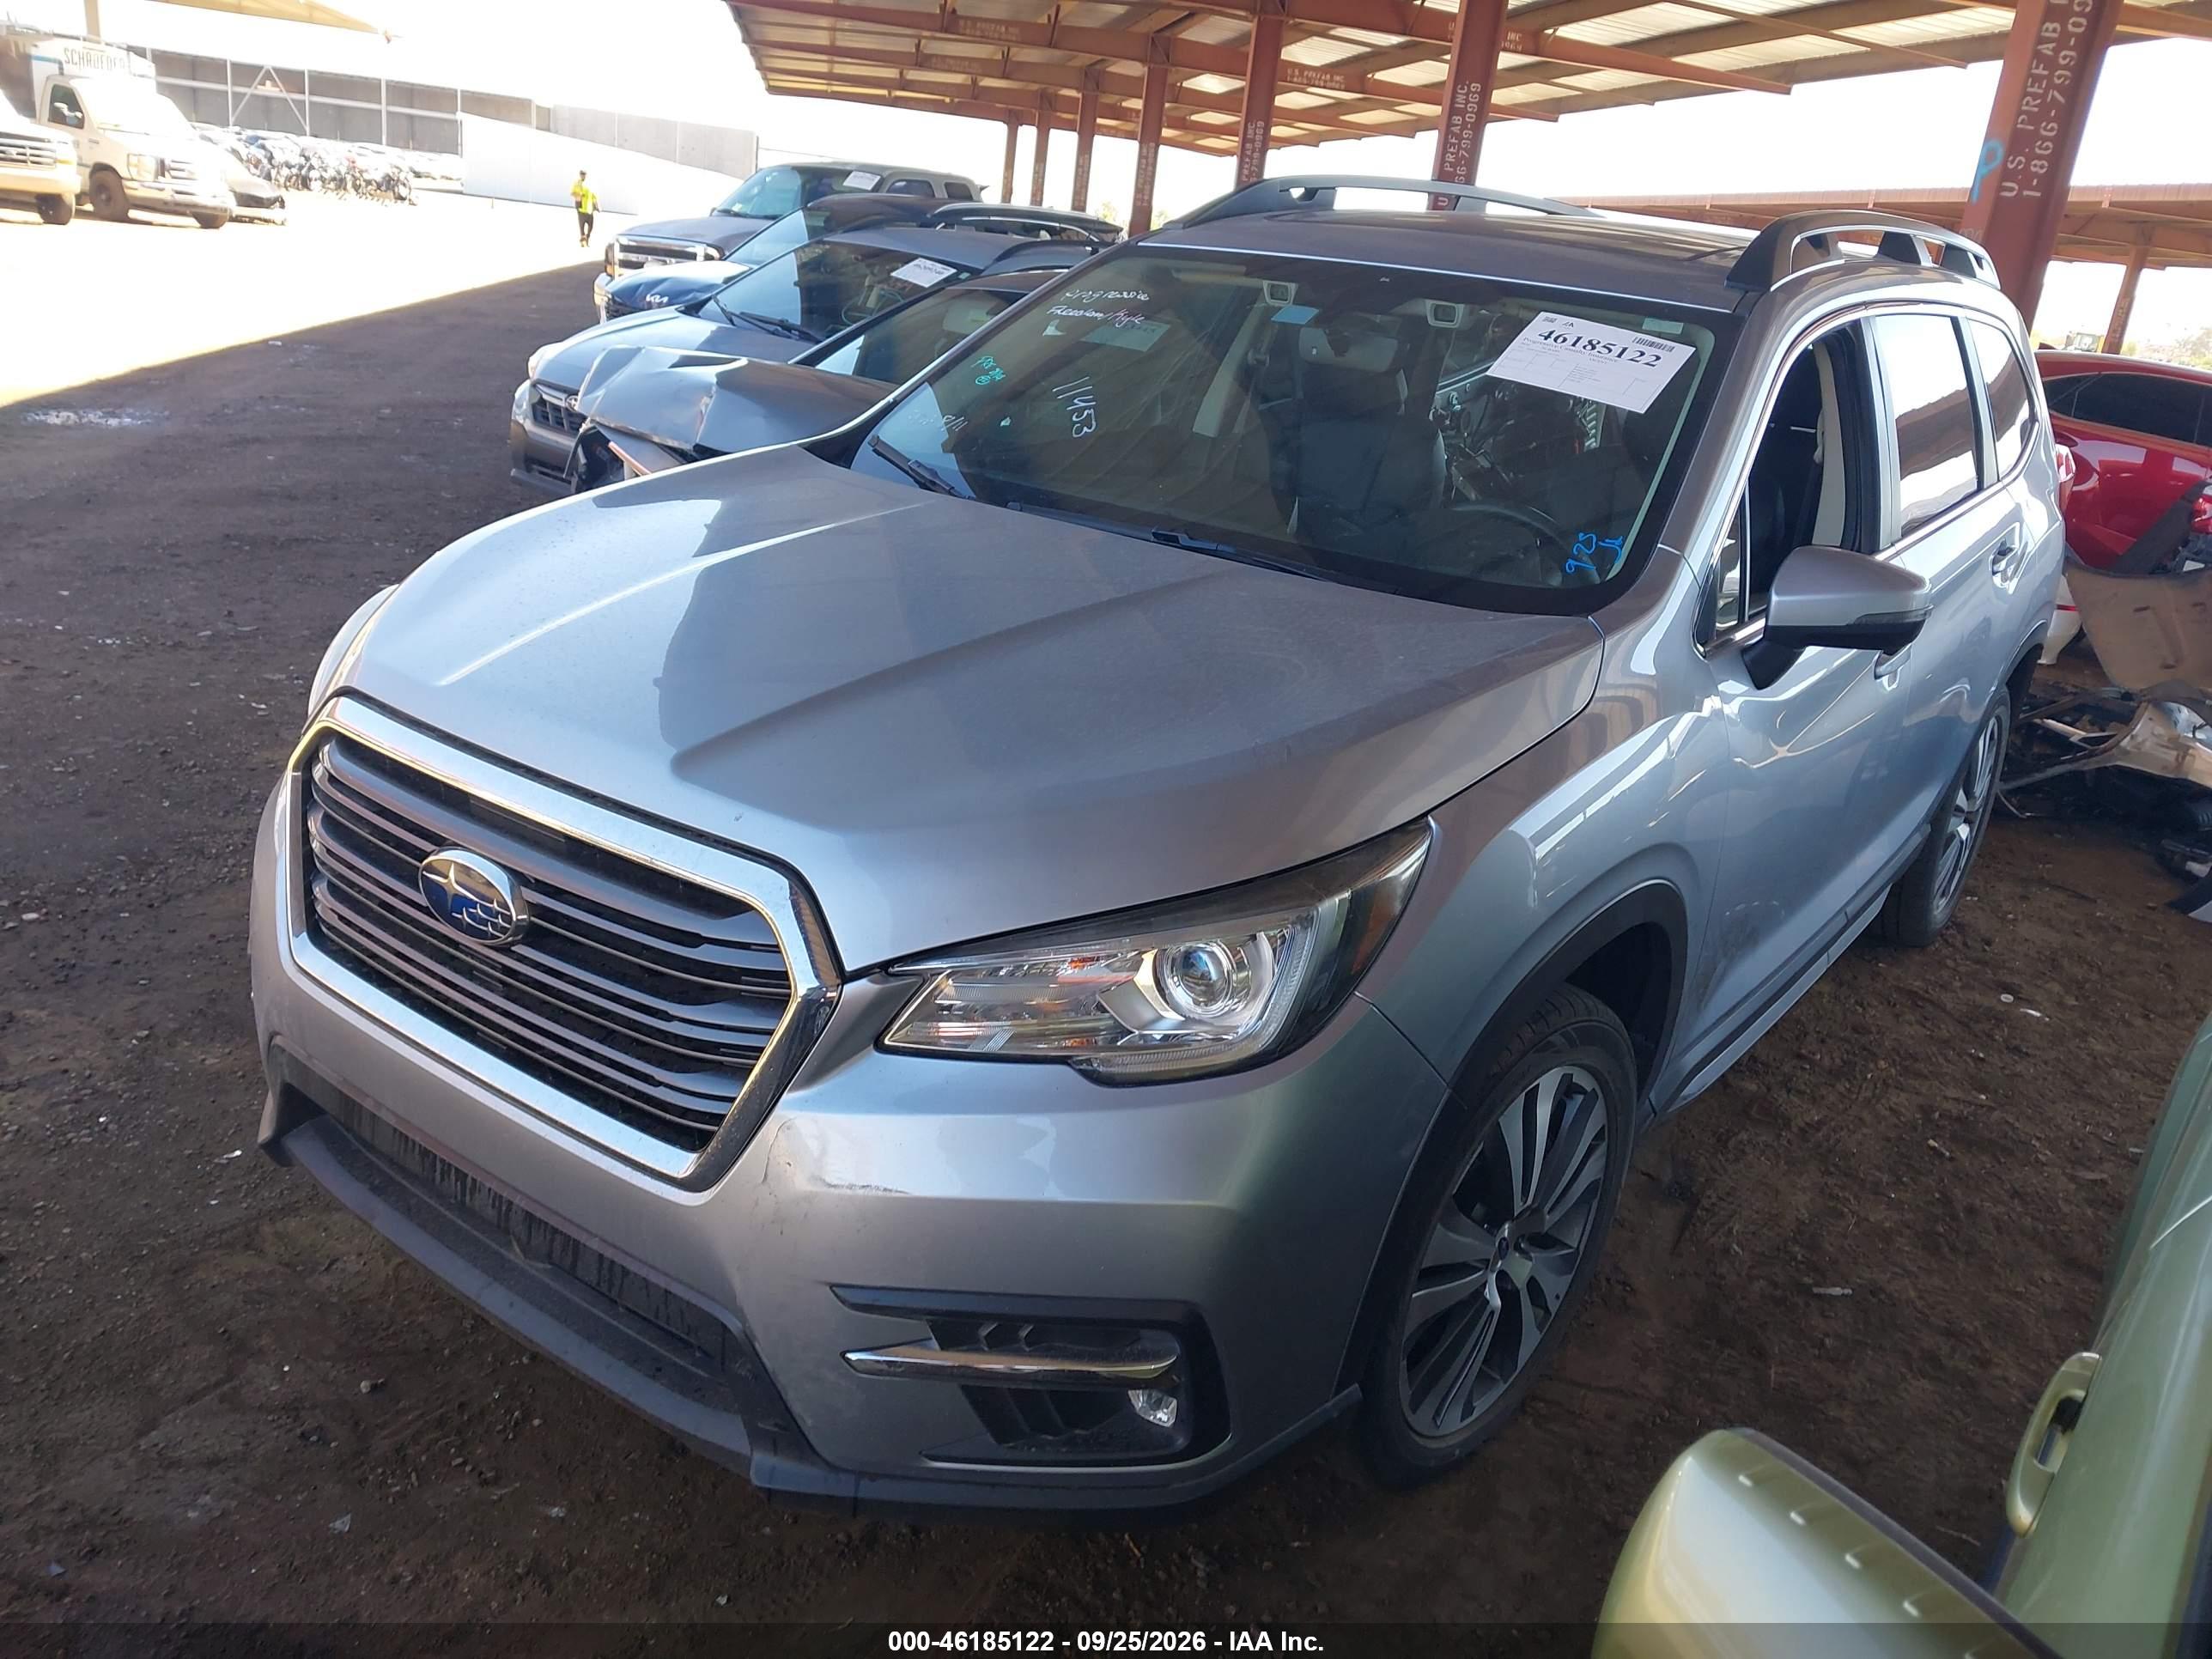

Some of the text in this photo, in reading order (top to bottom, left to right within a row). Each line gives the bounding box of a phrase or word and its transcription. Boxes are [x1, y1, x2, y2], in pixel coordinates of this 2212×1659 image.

[1455, 82, 1481, 183] 66-799-0969
[1999, 149, 2029, 197] U.S.
[2016, 21, 2061, 130] PREFAB
[1444, 116, 1462, 171] PREFAB
[1538, 329, 1662, 368] 46185122
[1052, 376, 1097, 437] 11453
